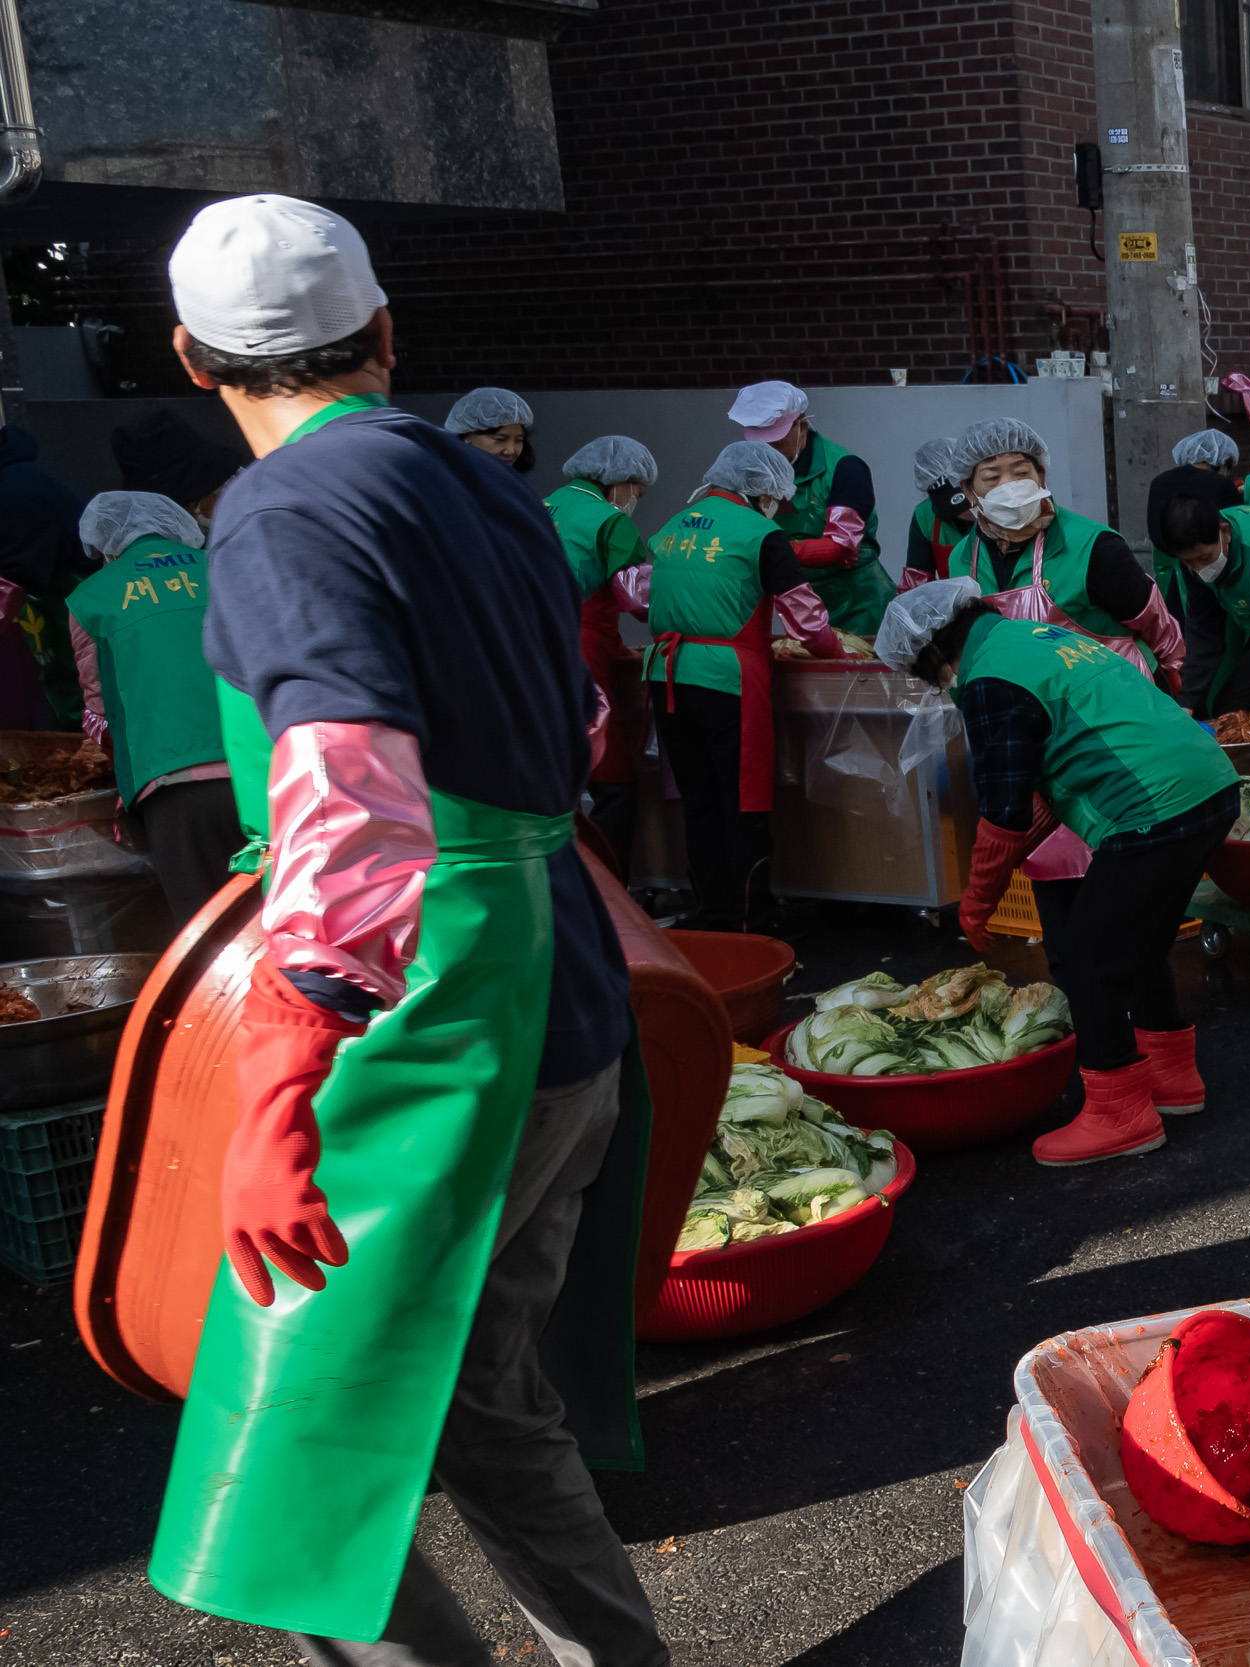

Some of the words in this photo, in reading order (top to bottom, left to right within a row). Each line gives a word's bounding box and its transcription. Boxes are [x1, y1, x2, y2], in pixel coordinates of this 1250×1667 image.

[679, 516, 715, 530] SMU
[654, 533, 724, 563] 새마을
[134, 553, 197, 572] SMU
[1055, 639, 1119, 670] 새마
